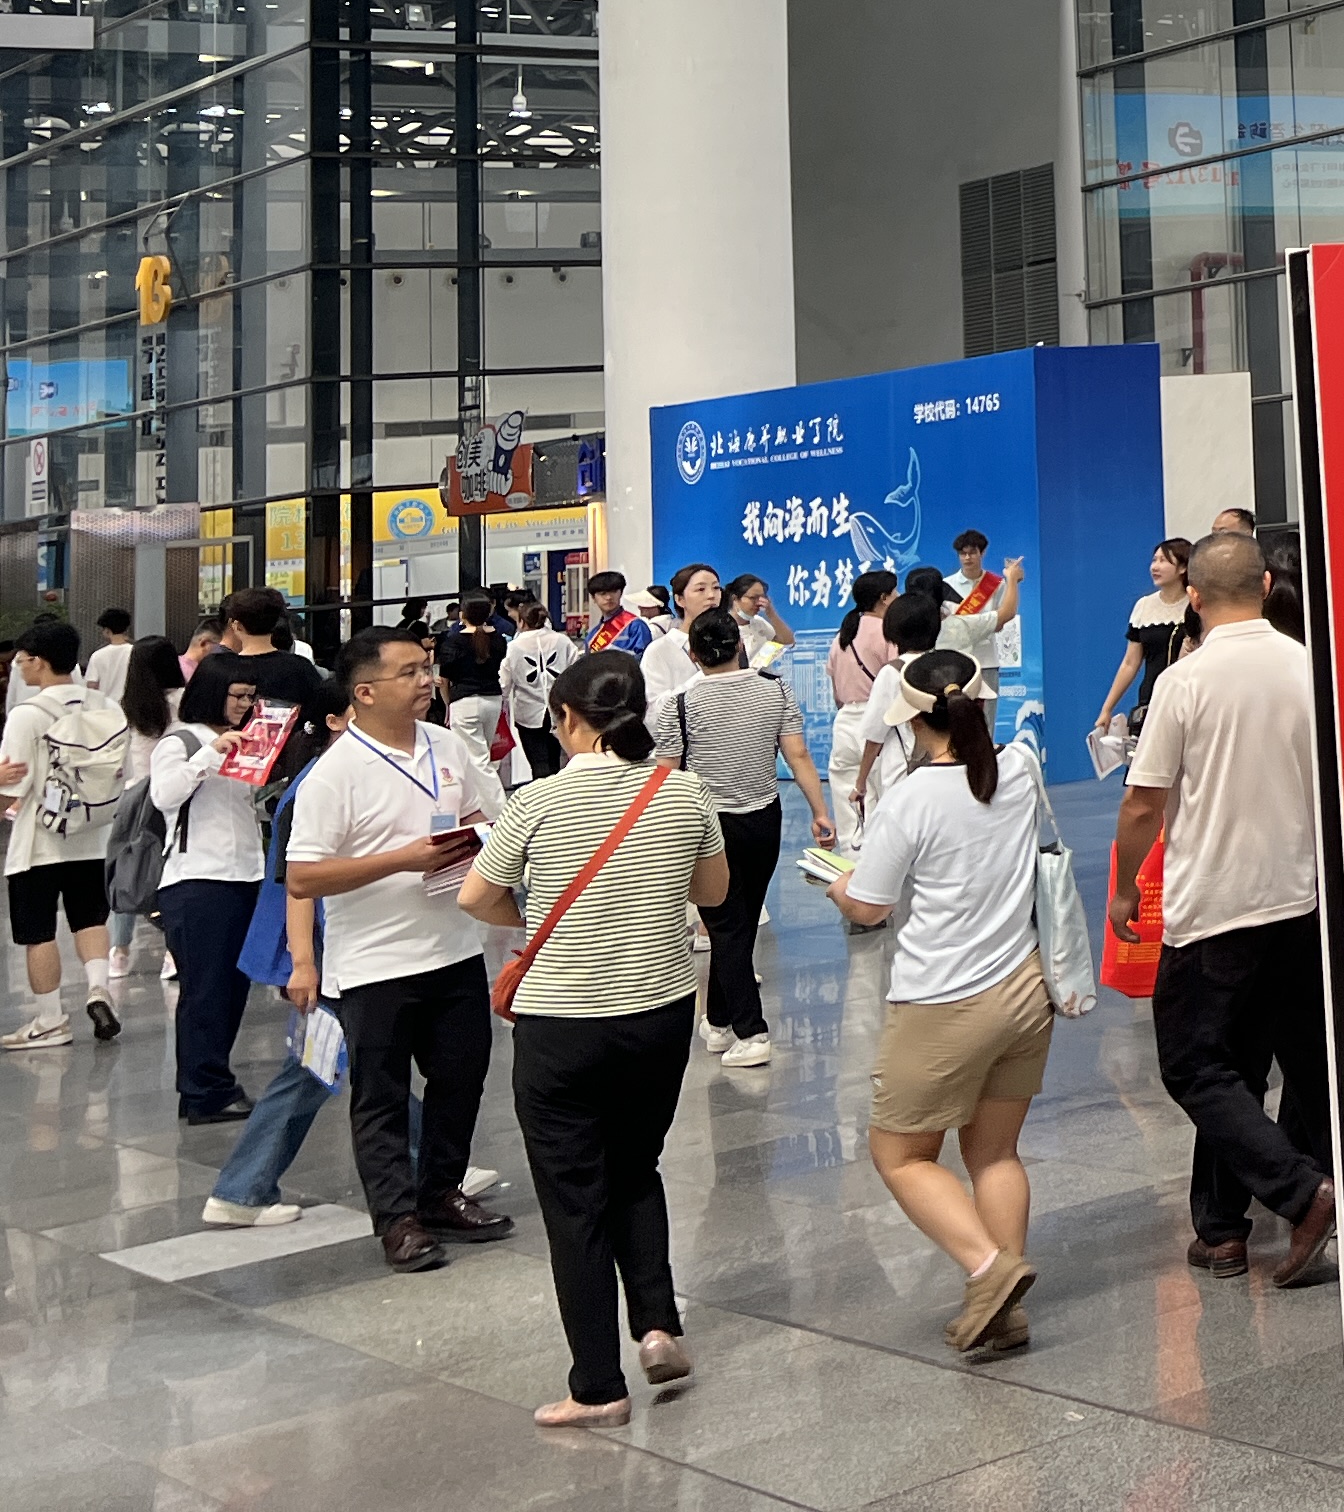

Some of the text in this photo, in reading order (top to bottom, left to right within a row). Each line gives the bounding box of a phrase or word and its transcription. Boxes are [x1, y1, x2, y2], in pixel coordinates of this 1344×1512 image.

[741, 492, 852, 546] 我向海而生
